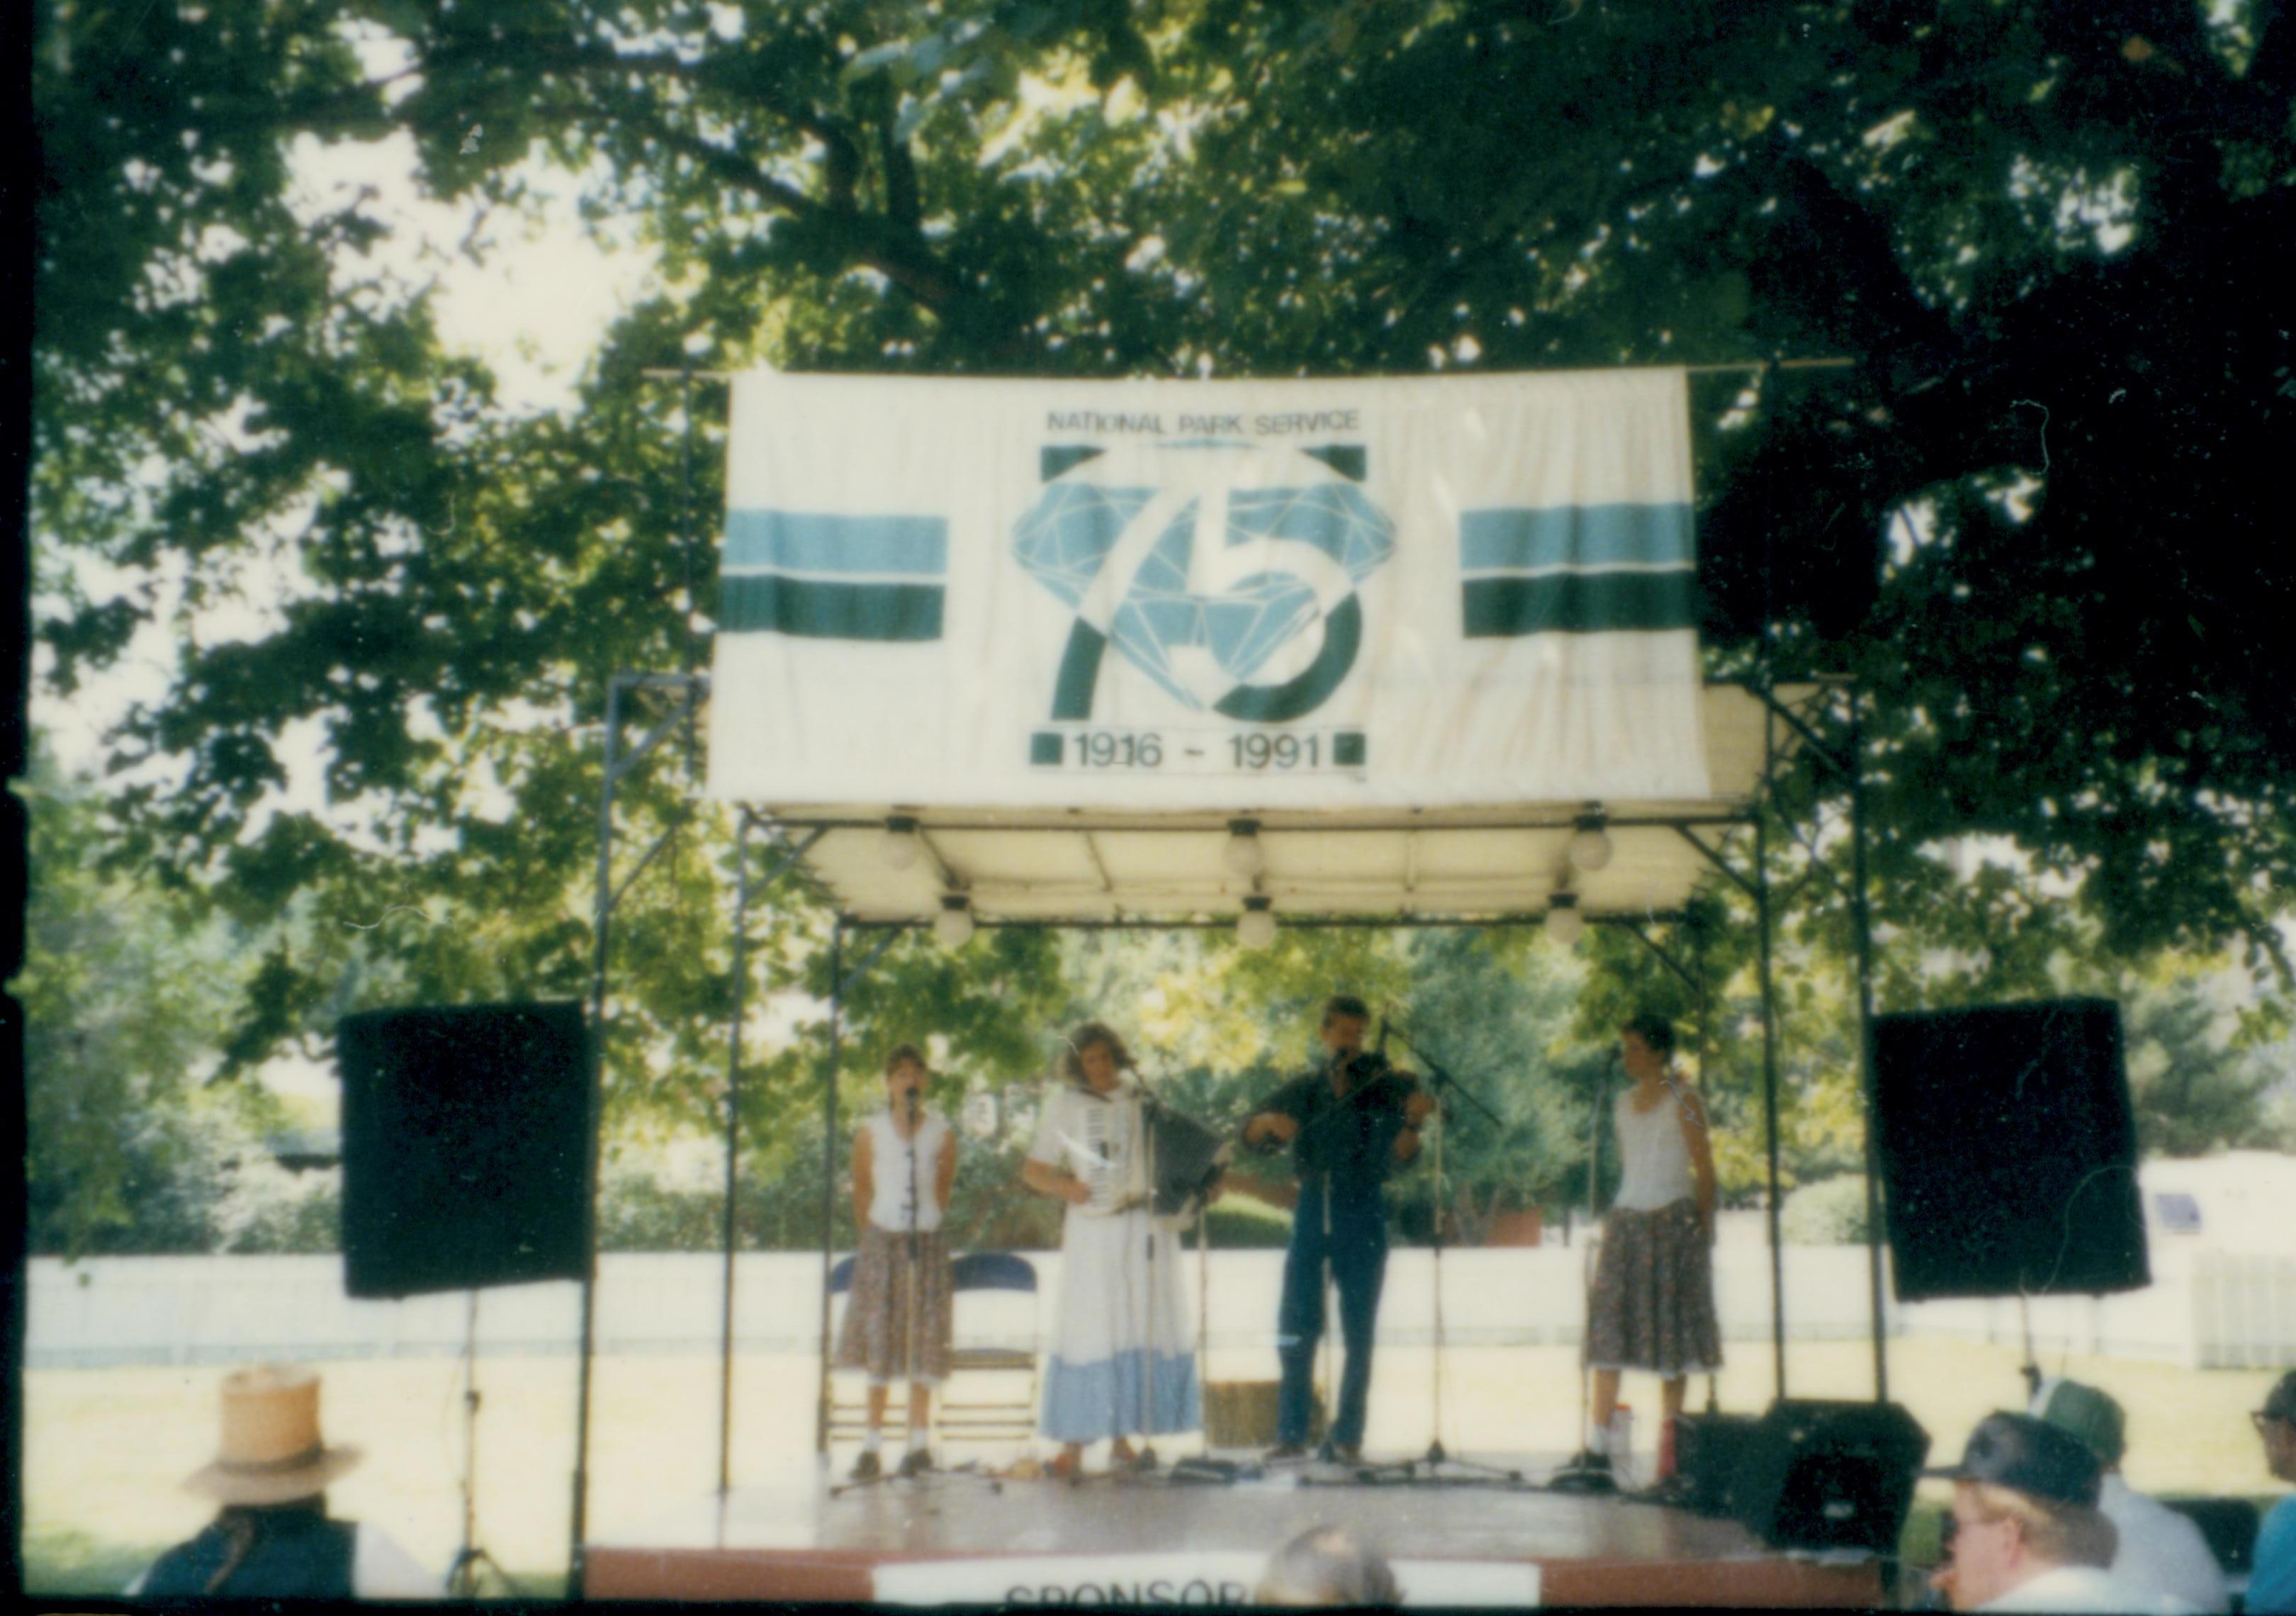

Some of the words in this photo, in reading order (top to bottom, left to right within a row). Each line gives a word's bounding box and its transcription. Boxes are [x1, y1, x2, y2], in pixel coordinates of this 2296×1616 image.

[1047, 410, 1164, 434] NATIONAL
[1178, 413, 1244, 434] PARK
[1254, 408, 1360, 435] SERVICE
[1040, 451, 1363, 724] 75
[1074, 731, 1163, 768] 1916
[1227, 732, 1319, 768] 1991
